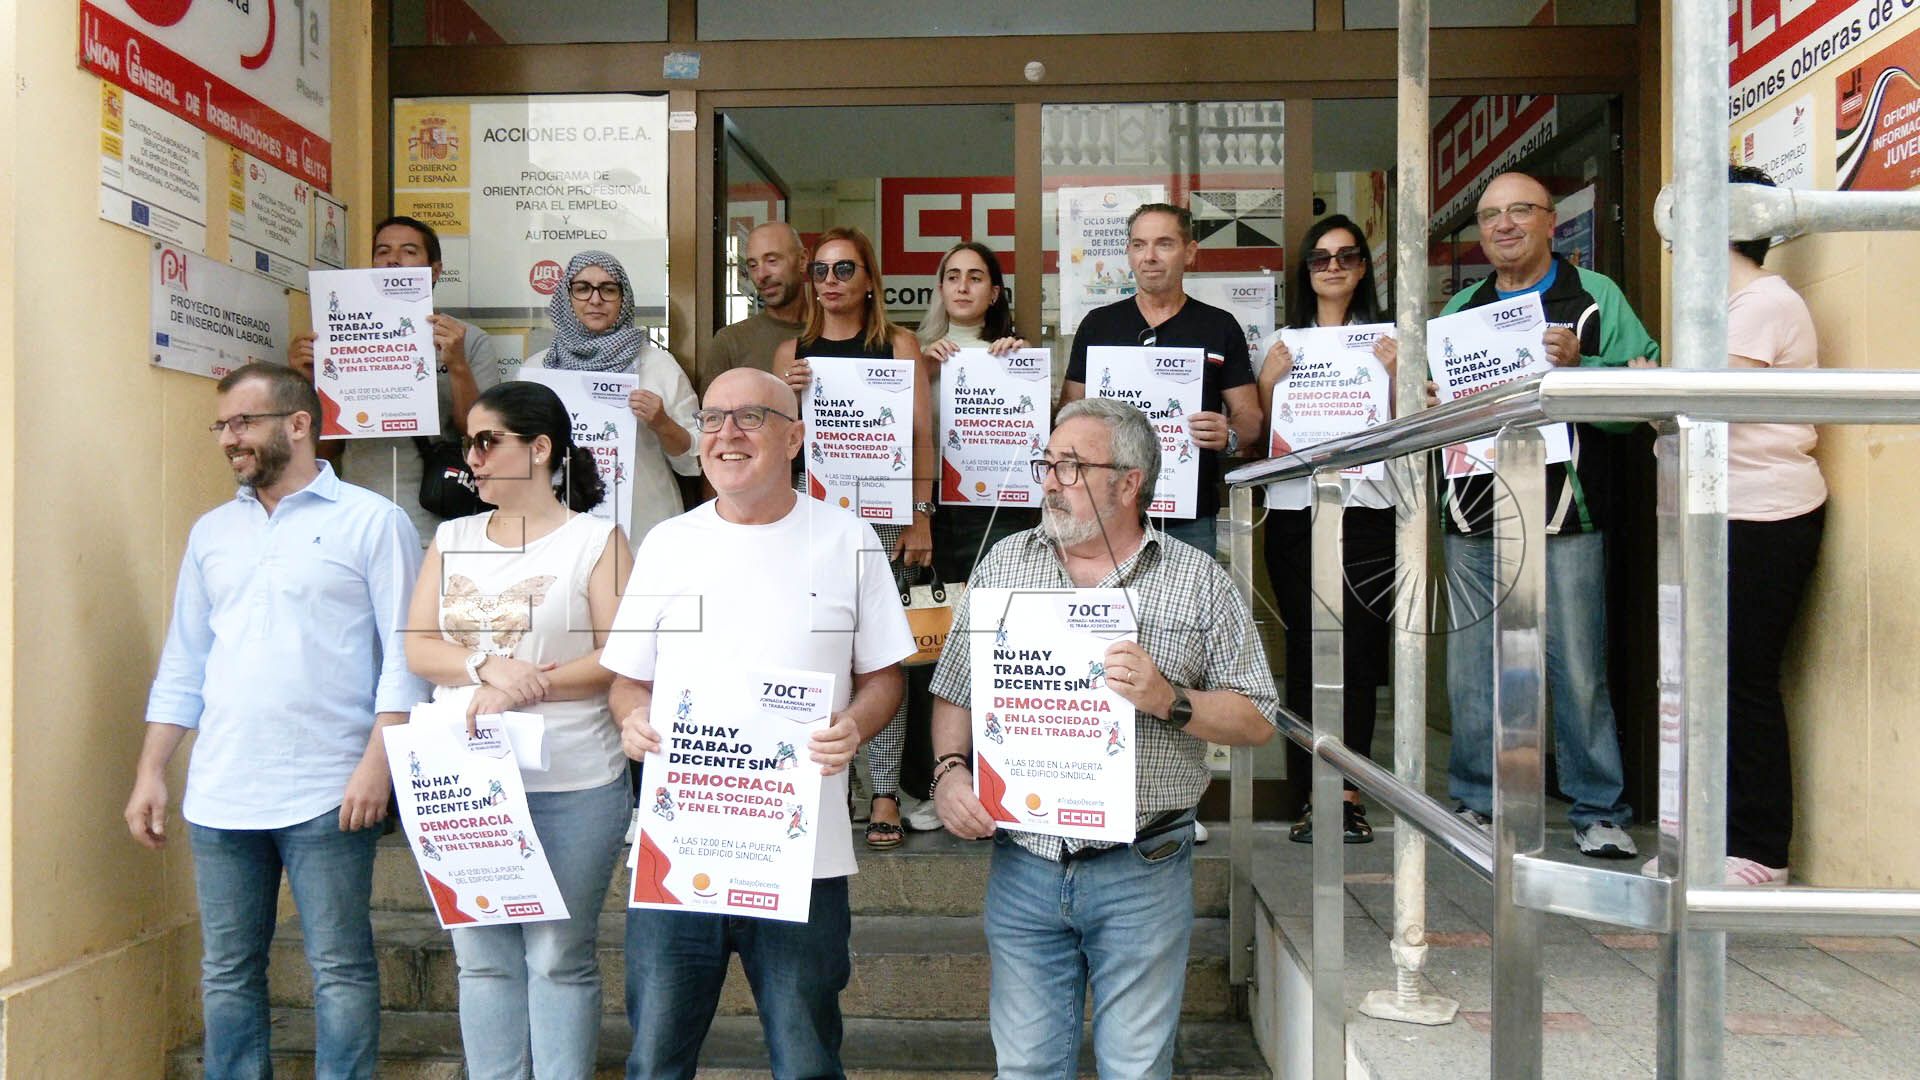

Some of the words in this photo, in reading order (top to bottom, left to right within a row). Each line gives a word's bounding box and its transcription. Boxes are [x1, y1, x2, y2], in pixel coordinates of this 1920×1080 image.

[1729, 67, 1785, 120] isiones
[1791, 18, 1861, 80] obreras
[1868, 0, 1893, 30] de
[126, 38, 179, 105] GENERAL
[185, 91, 200, 117] DE
[205, 81, 281, 159] TRABAJADORES
[286, 144, 298, 166] DE
[303, 137, 327, 185] CEUTA
[483, 127, 577, 142] ACCIONES
[583, 126, 652, 142] O.P.E.A.
[1873, 117, 1920, 152] INFORMAC
[1883, 136, 1920, 169] JUVE
[409, 164, 457, 172] GOBIERNO
[408, 174, 420, 183] DE
[423, 173, 457, 183] ESPAÑA
[521, 171, 591, 181] PROGRAMA
[594, 171, 610, 181] DE
[483, 183, 565, 197] ORIENTACIÓN
[567, 184, 652, 196] PROFESIONAL
[515, 200, 548, 211] PARA
[551, 200, 566, 210] EL
[568, 200, 618, 210] EMPLEO
[421, 211, 454, 219] TRABAJO
[562, 215, 570, 224] Y
[1084, 217, 1105, 226] CICLO
[1107, 216, 1129, 225] SUPER
[525, 229, 608, 241] AUTOEMPLEO
[1083, 229, 1093, 237] DE
[1091, 239, 1101, 247] DE
[534, 265, 560, 280] UGT
[1232, 288, 1238, 296] 7
[1239, 288, 1258, 296] OCT
[170, 294, 220, 319] PROYECTO
[223, 310, 270, 333] INTEGRADO
[328, 313, 345, 321] NO
[348, 312, 373, 320] HAY
[170, 310, 183, 323] DE
[186, 314, 234, 337] INSERCIÓN
[236, 328, 274, 349] LABORAL
[329, 322, 383, 332] TRABAJO
[329, 332, 380, 342] DECENTE
[383, 329, 402, 339] SIN
[330, 343, 417, 355] DEMOCRACIA
[814, 399, 829, 407] NO
[830, 399, 854, 407] HAY
[814, 409, 864, 418] TRABAJO
[815, 419, 861, 428] DECENTE
[863, 418, 882, 428] SIN
[816, 431, 896, 442] DEMOCRACIA
[1068, 604, 1077, 617] 7
[1080, 604, 1111, 617] OCT
[913, 633, 949, 646] TOU
[993, 649, 1016, 661] NO
[1019, 650, 1052, 661] HAY
[993, 664, 1066, 676] TRABAJO
[763, 683, 773, 696] 7
[774, 684, 808, 700] OCT
[993, 678, 1062, 691] DECENTE
[1064, 678, 1090, 692] SIN
[993, 696, 1111, 713] DEMOCRACIA
[1005, 713, 1019, 722] EN
[1022, 713, 1036, 723] LA
[1038, 715, 1100, 726] SOCIEDAD
[672, 722, 698, 734] NO
[701, 724, 739, 739] HAY
[1005, 725, 1011, 734] Y
[1014, 725, 1029, 735] EN
[1031, 726, 1043, 736] EL
[1046, 728, 1102, 739] TRABAJO
[671, 737, 753, 755] TRABAJO
[669, 753, 745, 770] DECENTE
[748, 758, 778, 771] SIN
[1011, 758, 1026, 767] LAS
[1028, 759, 1045, 768] 12:00
[1047, 760, 1057, 768] EN
[1072, 762, 1102, 771] PUERTA
[1010, 768, 1024, 776] DEL
[1027, 768, 1058, 779] EDIFICIO
[1060, 770, 1095, 781] SINDICAL
[412, 779, 431, 789] NO
[433, 774, 460, 787] HAY
[667, 771, 796, 795] DEMOCRACIA
[414, 787, 472, 802] TRABAJO
[678, 790, 696, 800] EN
[697, 791, 713, 801] LA
[716, 793, 783, 807] SOCIEDAD
[417, 801, 470, 816] DECENTE
[472, 796, 492, 810] SIN
[676, 802, 685, 811] Y
[688, 803, 706, 813] EN
[707, 804, 721, 814] EL
[722, 806, 785, 821] TRABAJO
[420, 814, 513, 832] DEMOCRACIA
